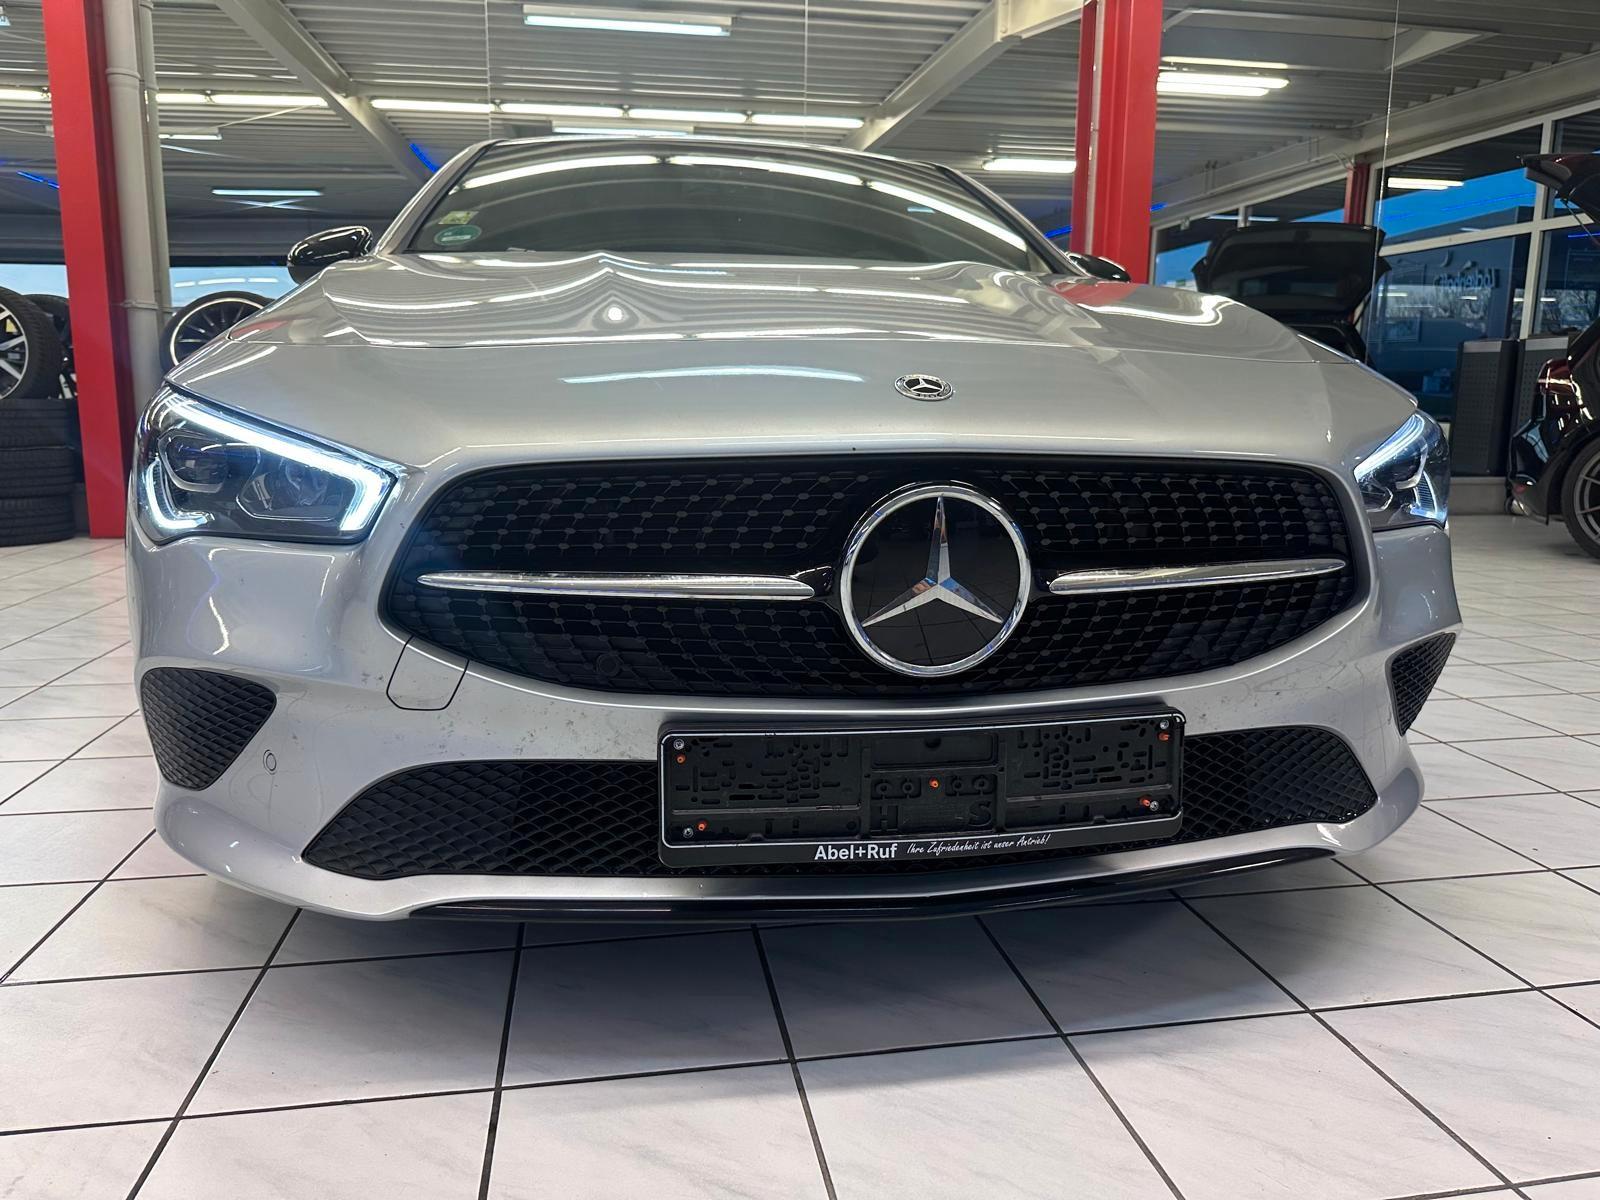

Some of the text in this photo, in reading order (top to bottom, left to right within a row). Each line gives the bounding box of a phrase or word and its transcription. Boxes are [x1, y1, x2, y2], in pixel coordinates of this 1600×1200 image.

[814, 843, 898, 860] Abel+Ruf
[907, 833, 1051, 856] Ihre Zufriedenheit ist unser Antrieb!
